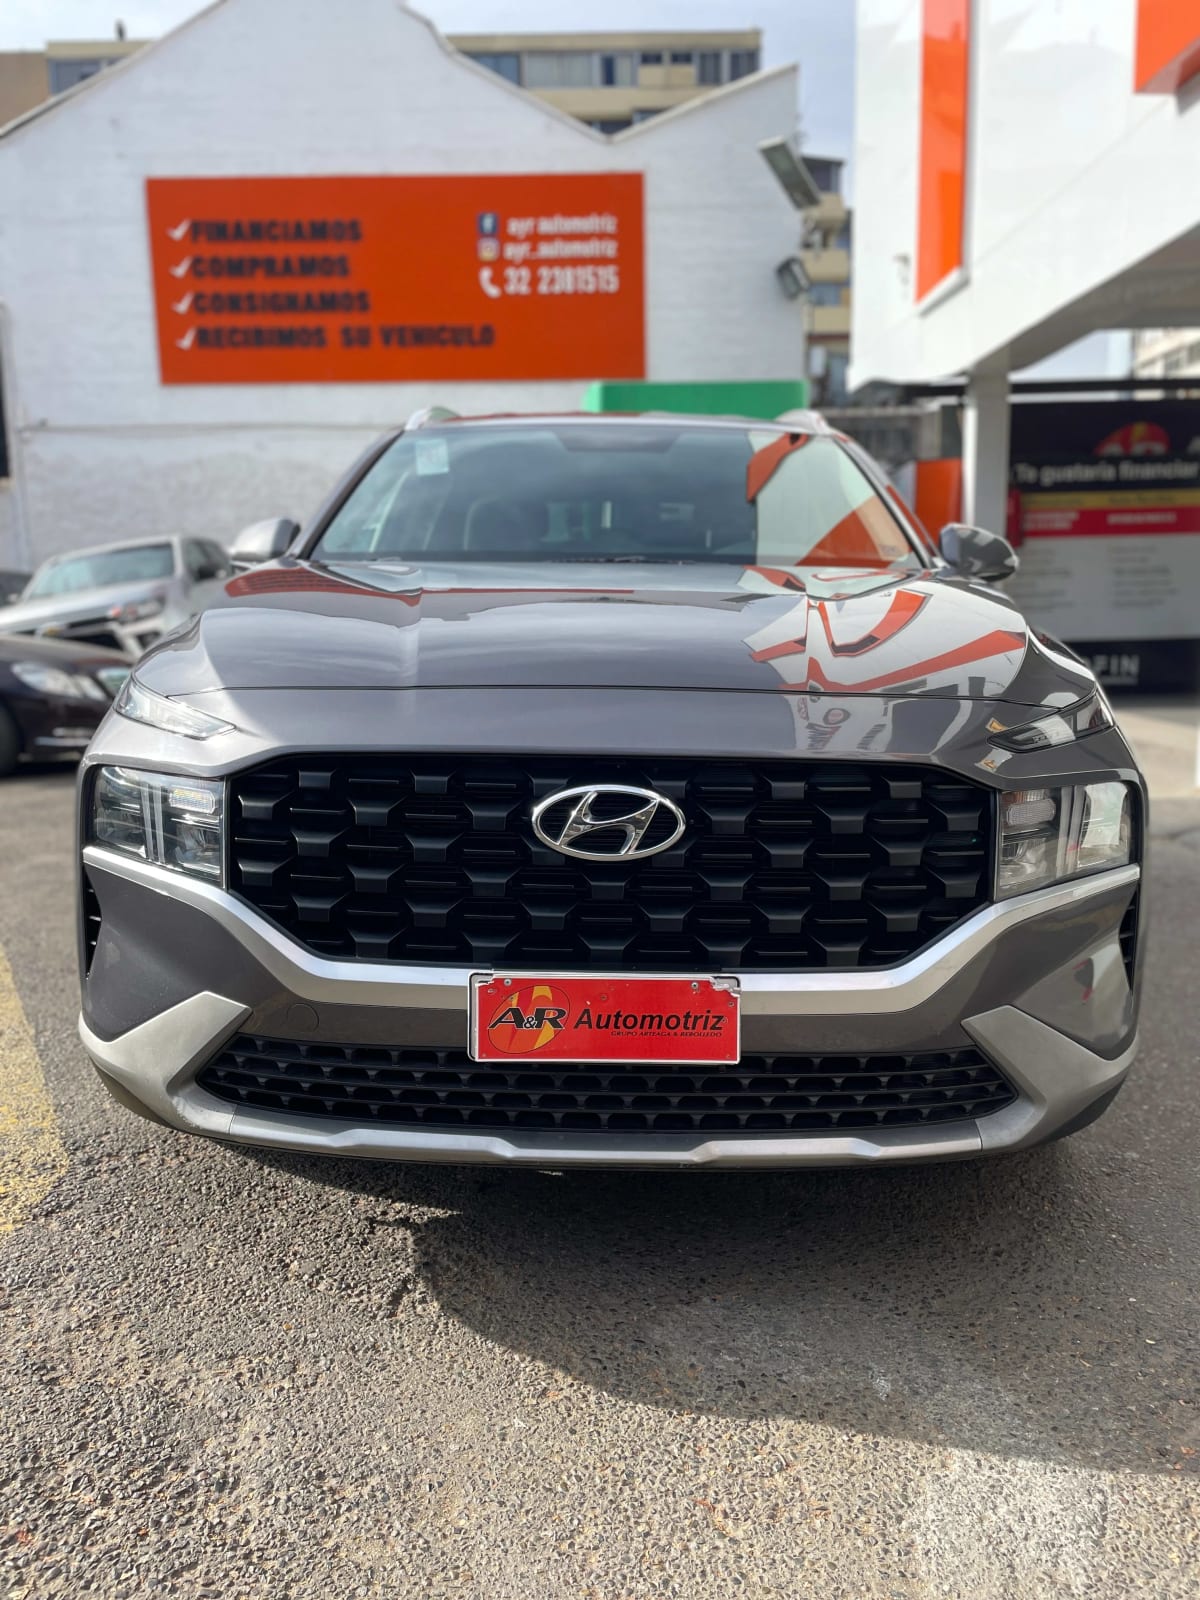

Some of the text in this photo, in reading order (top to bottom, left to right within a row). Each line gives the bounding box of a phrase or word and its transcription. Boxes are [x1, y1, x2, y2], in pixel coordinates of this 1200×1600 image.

[192, 219, 362, 242] FINANCIAMOS
[192, 255, 349, 278] COMPRAMOS
[504, 266, 532, 294] 32
[194, 291, 371, 314] CONSIGNAMOS
[197, 326, 325, 348] RECIBIMOS
[341, 325, 372, 348] SU
[488, 1007, 724, 1031] A&R Automotriz
